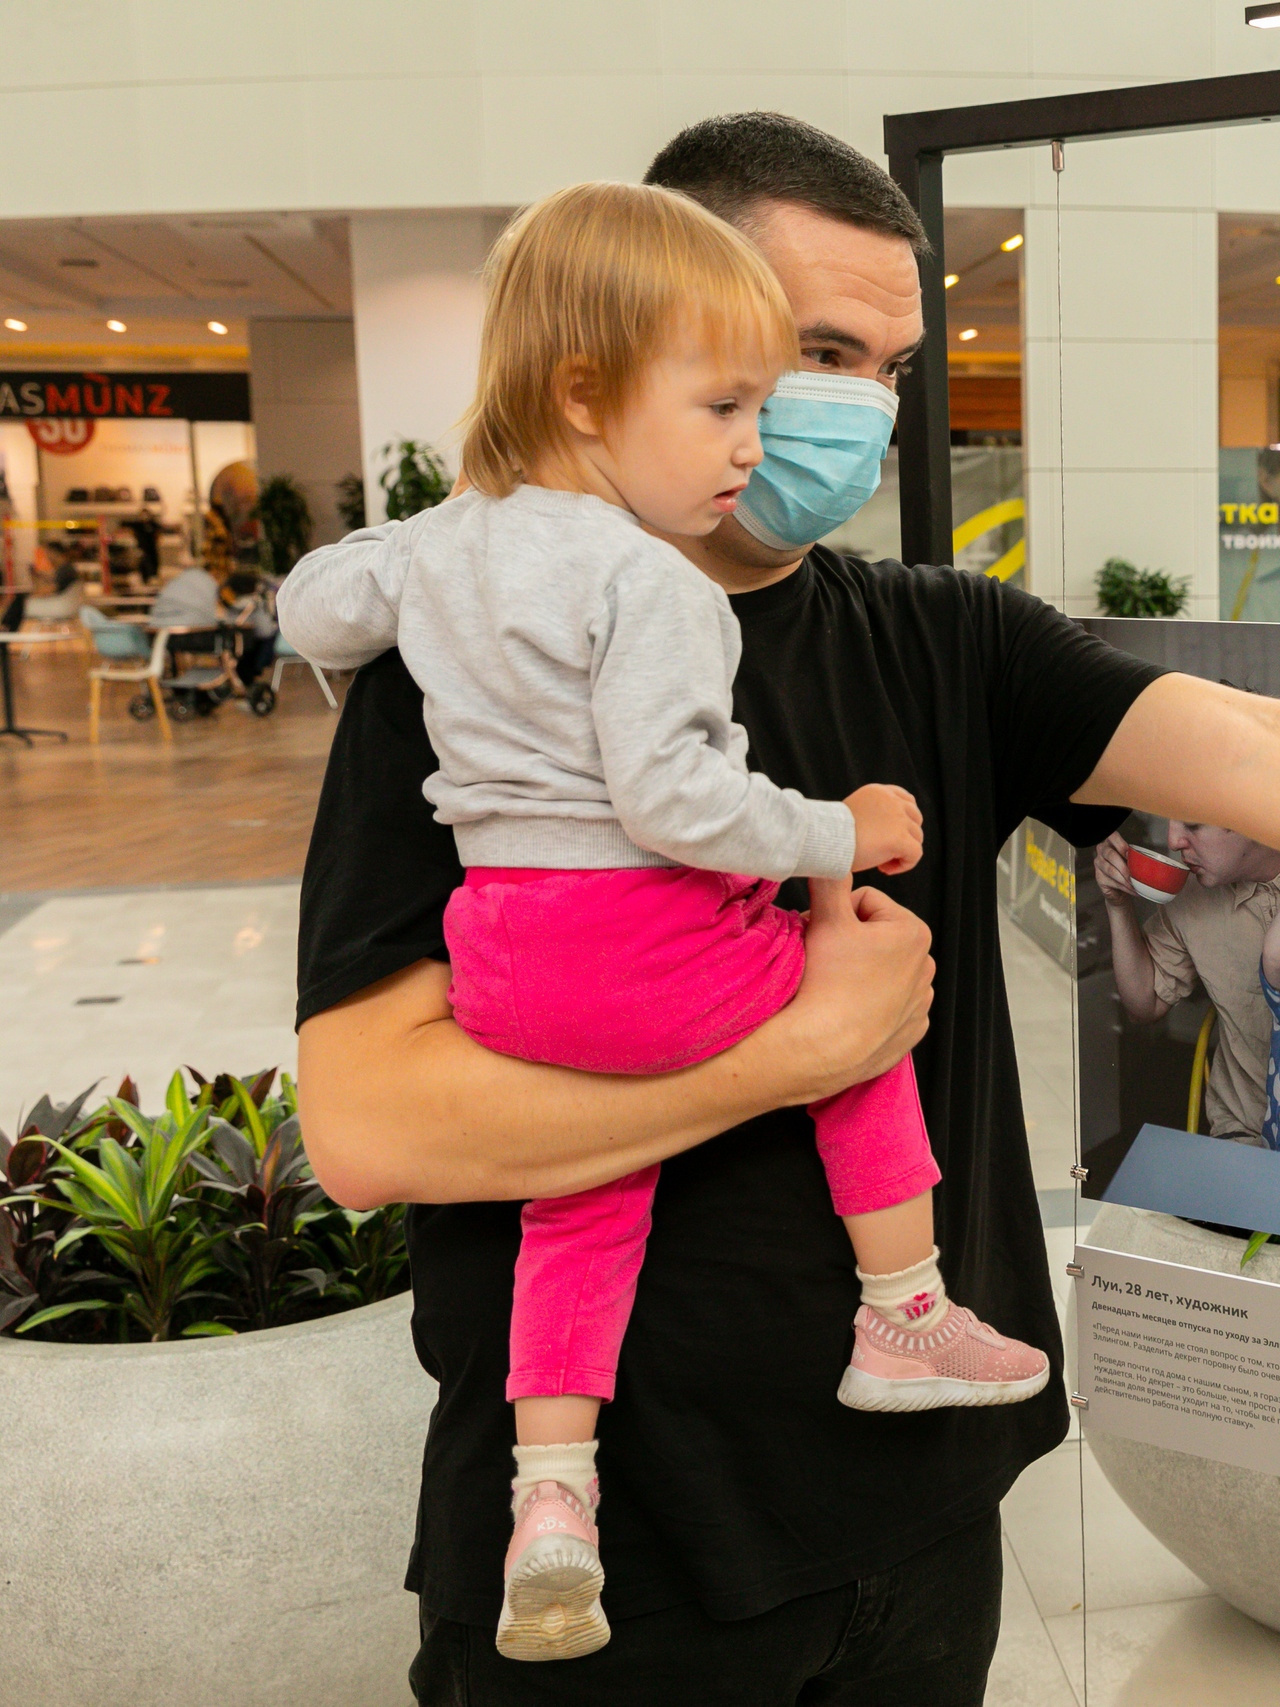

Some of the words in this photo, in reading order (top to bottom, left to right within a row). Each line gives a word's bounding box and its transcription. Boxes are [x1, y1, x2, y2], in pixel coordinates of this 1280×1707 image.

[1219, 502, 1279, 525] тка
[1090, 1274, 1123, 1295] Луи,
[1124, 1281, 1142, 1297] 28
[1144, 1288, 1174, 1306] лет,
[1175, 1294, 1249, 1320] художник
[1090, 1300, 1141, 1319] Двенадцать
[1141, 1312, 1177, 1327] месяцев
[1177, 1320, 1212, 1334] отпуска
[1212, 1328, 1224, 1337] по
[1224, 1330, 1250, 1344] уходу
[1250, 1335, 1262, 1345] за
[1092, 1321, 1121, 1336] «Перед
[1120, 1329, 1142, 1339] нами
[1142, 1334, 1174, 1348] никогда
[1174, 1341, 1186, 1350] не
[1185, 1343, 1209, 1355] стоял
[1209, 1348, 1239, 1362] вопрос
[1239, 1355, 1246, 1363] о
[1246, 1356, 1265, 1368] том,
[1265, 1361, 1280, 1371] кто
[1092, 1352, 1126, 1368] Проведя
[1126, 1361, 1151, 1373] почти
[1150, 1367, 1166, 1378] год
[1165, 1370, 1186, 1382] дома
[1186, 1375, 1192, 1383] с
[1192, 1376, 1222, 1389] нашим
[1222, 1383, 1252, 1398] сыном,
[1252, 1390, 1259, 1398] я
